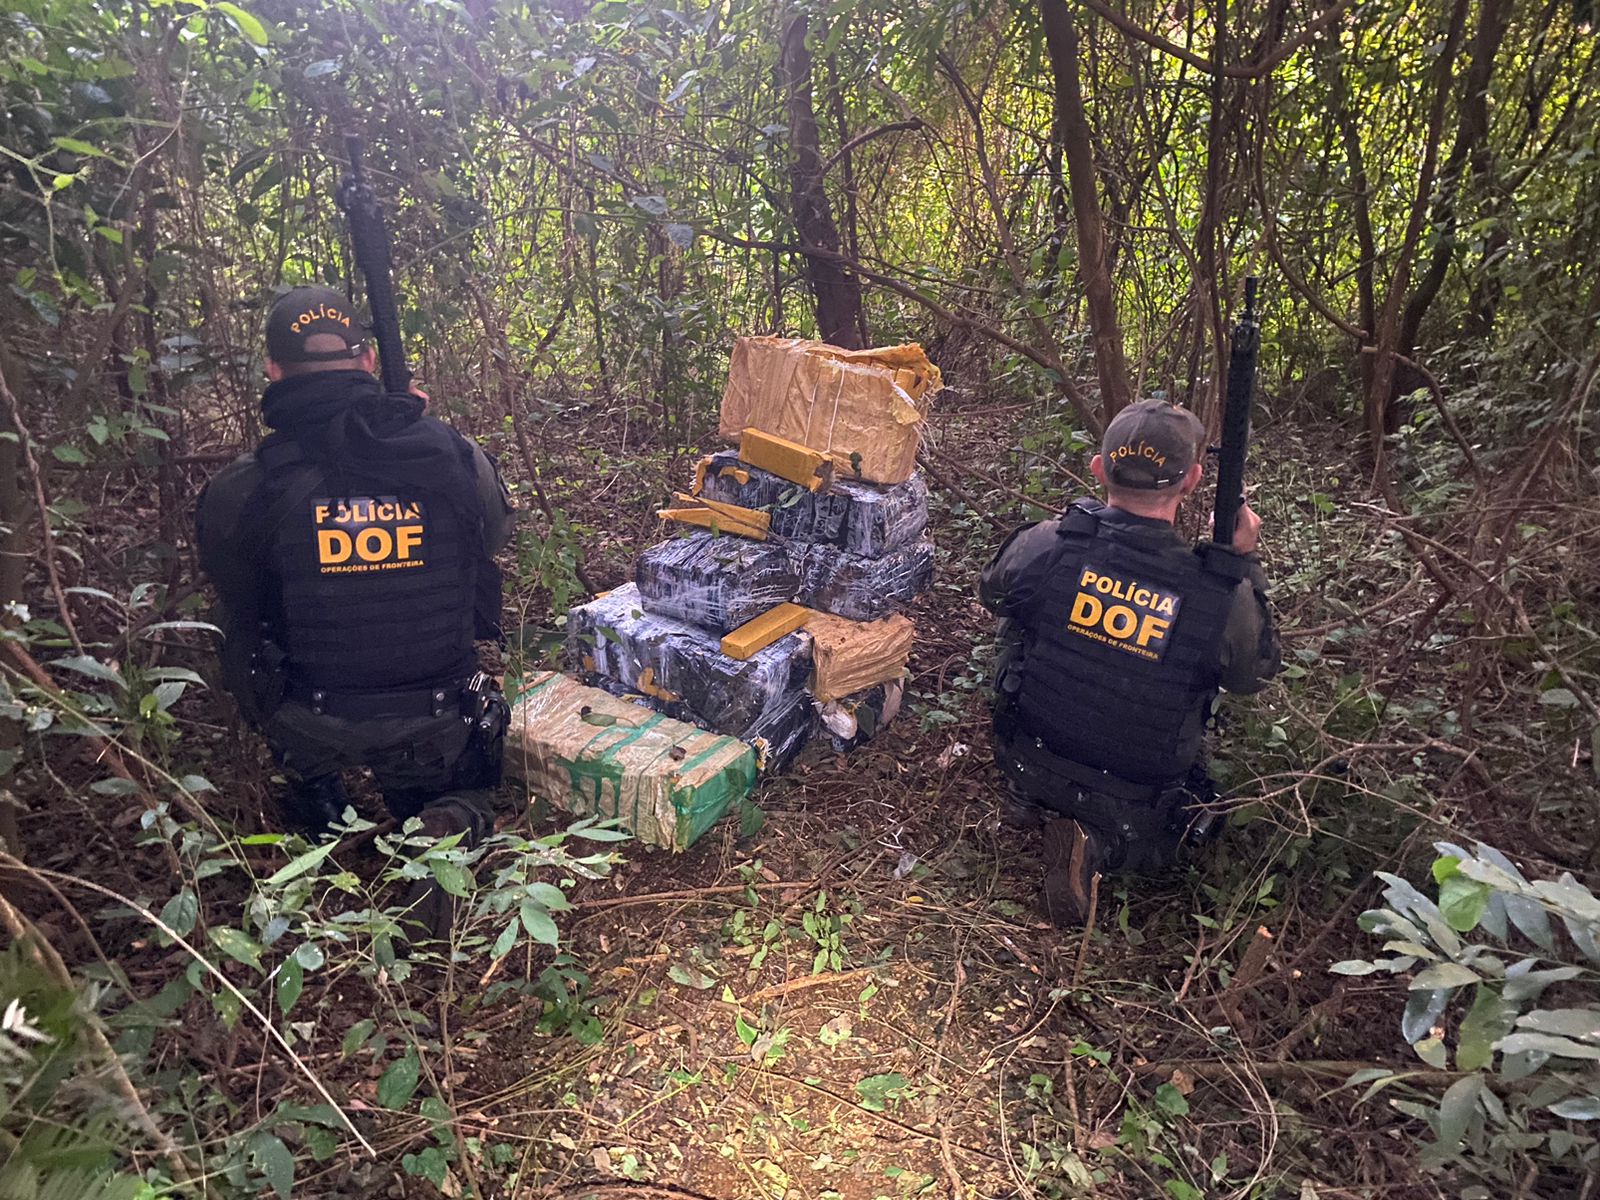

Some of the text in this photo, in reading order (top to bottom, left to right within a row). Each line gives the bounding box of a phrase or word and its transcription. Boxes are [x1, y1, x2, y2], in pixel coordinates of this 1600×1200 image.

[290, 303, 350, 334] POLÍCIA
[1109, 440, 1166, 468] POLÍCIA
[317, 525, 423, 564] DOF
[320, 559, 424, 574] OPERAÇÕES DE FRONTEIRA
[1080, 570, 1173, 616] POLÍCIA
[1069, 591, 1170, 647] DOF
[1067, 623, 1159, 660] OPERAÇÕES DE FRONTEIRA
